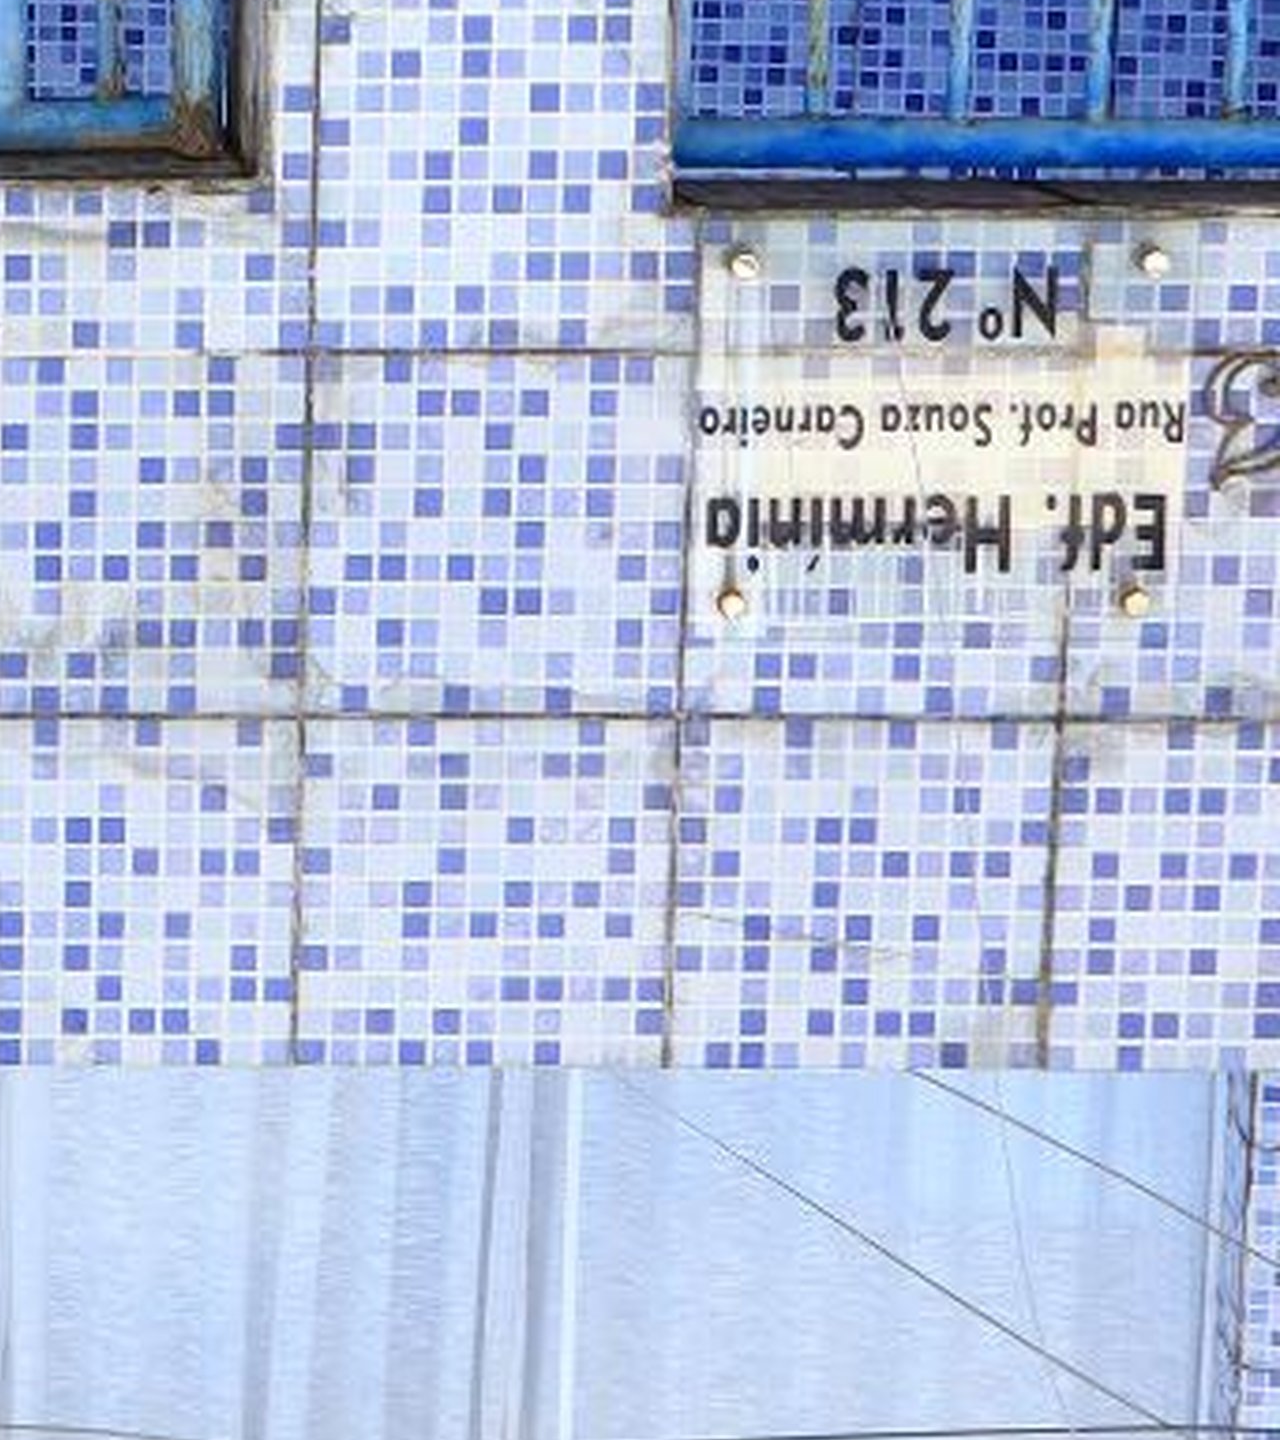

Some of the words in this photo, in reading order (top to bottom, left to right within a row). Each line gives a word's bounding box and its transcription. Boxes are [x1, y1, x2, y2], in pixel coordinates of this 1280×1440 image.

[833, 266, 955, 342] 213
[698, 402, 864, 449] Carneiro
[880, 400, 992, 447] Souza
[1009, 401, 1099, 447] Prof.
[1116, 400, 1186, 444] Rua
[705, 493, 1012, 573] Hermínia
[1045, 493, 1169, 572] Edf.
